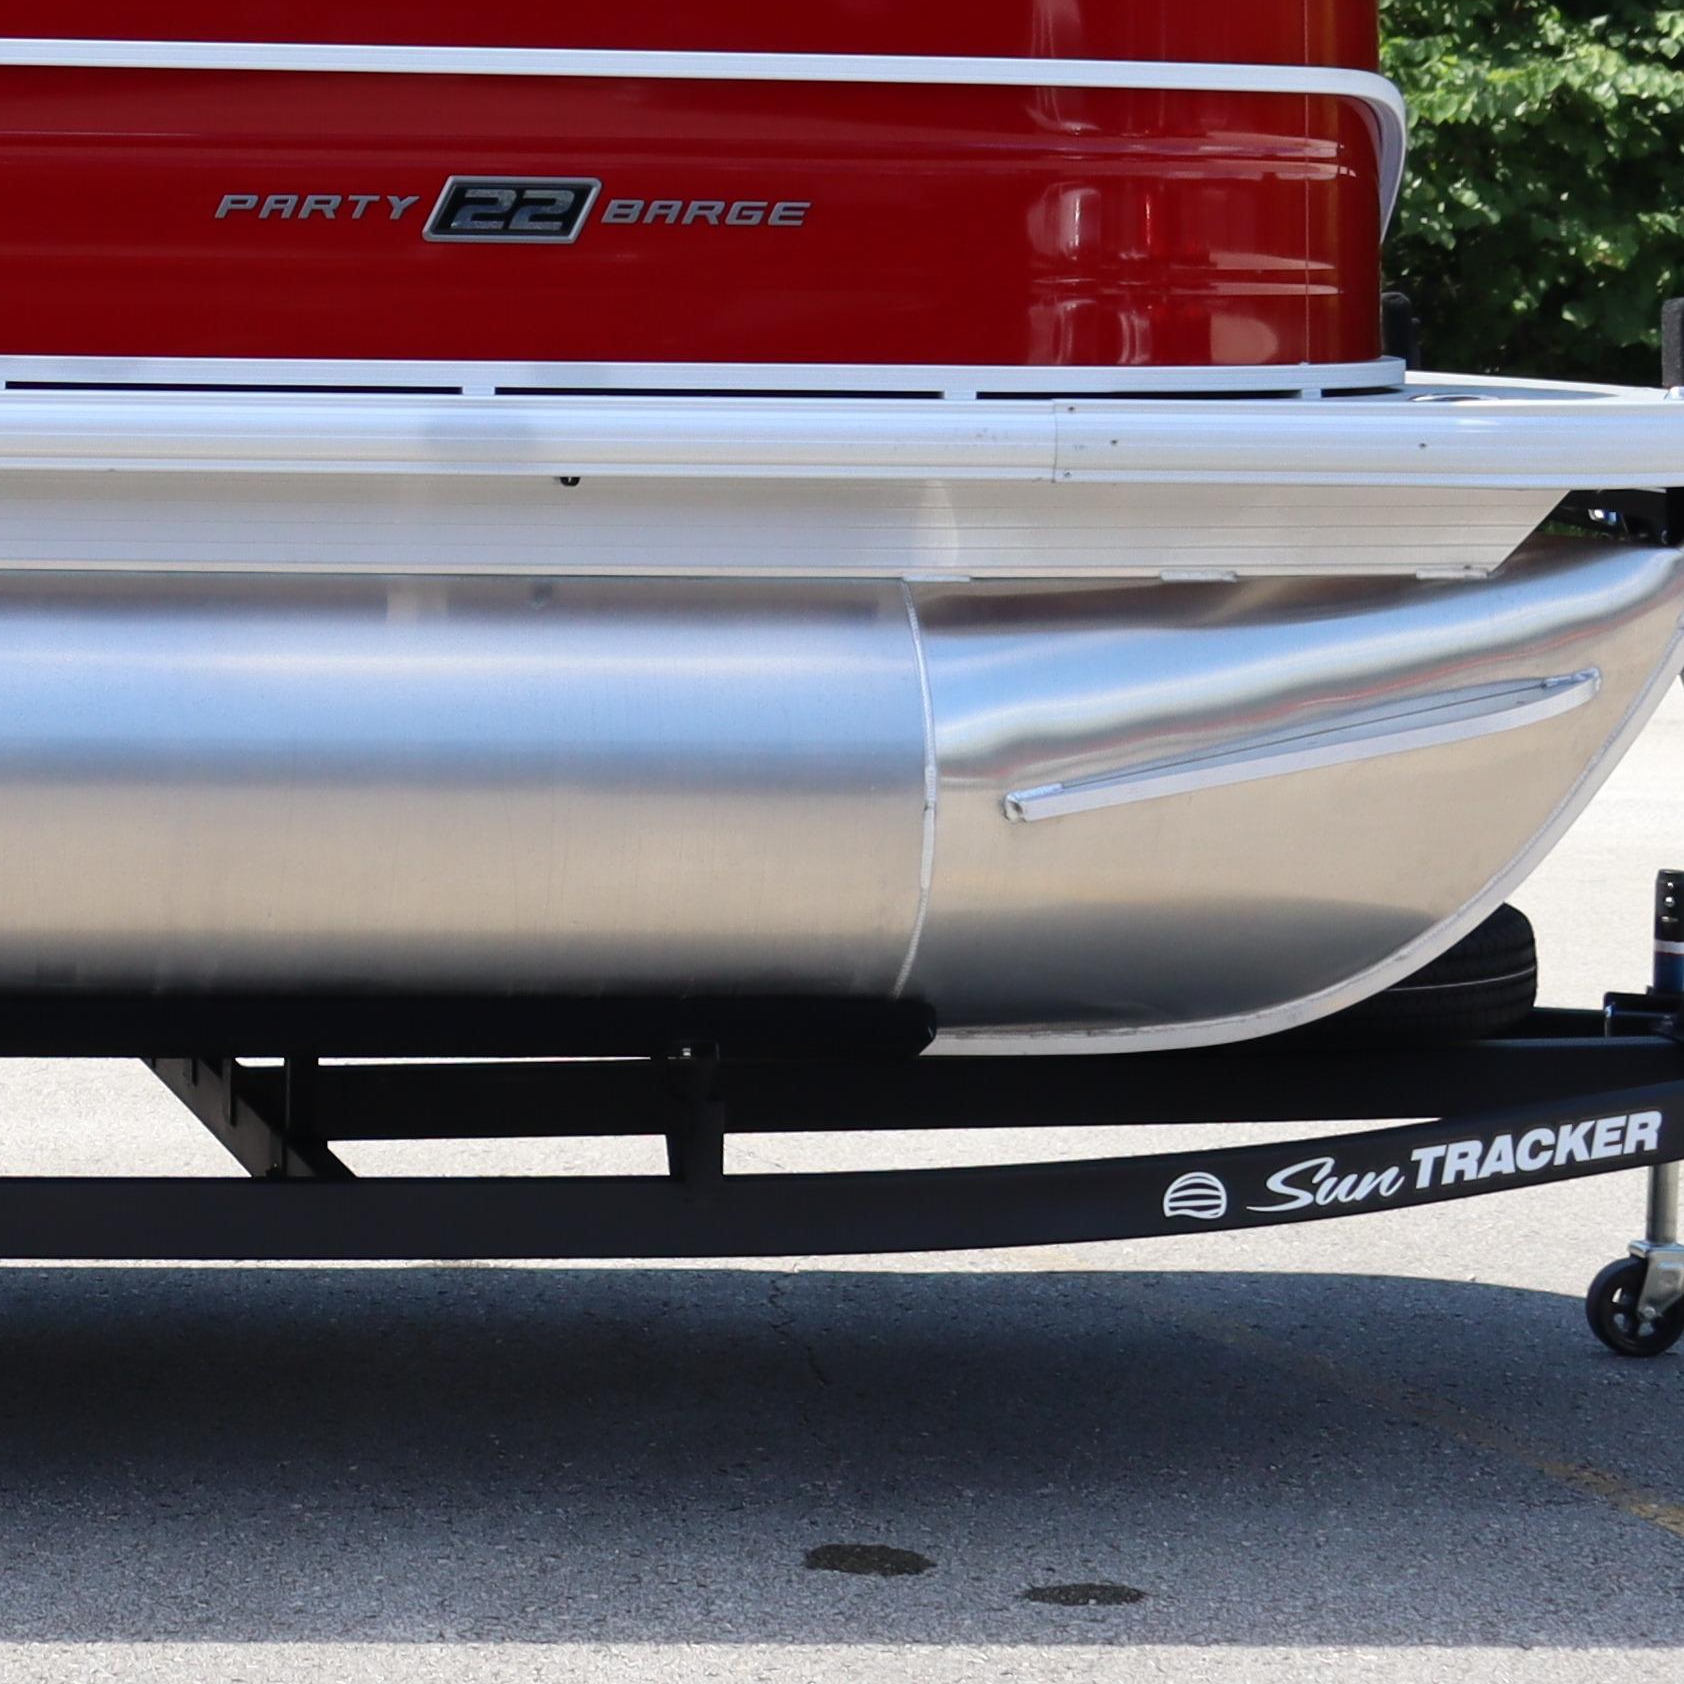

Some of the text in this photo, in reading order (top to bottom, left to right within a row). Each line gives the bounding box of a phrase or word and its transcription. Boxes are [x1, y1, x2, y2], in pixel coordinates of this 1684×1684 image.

[214, 189, 812, 230] PARTY 22 BARGE
[1246, 1111, 1662, 1212] Sun TRACKER
